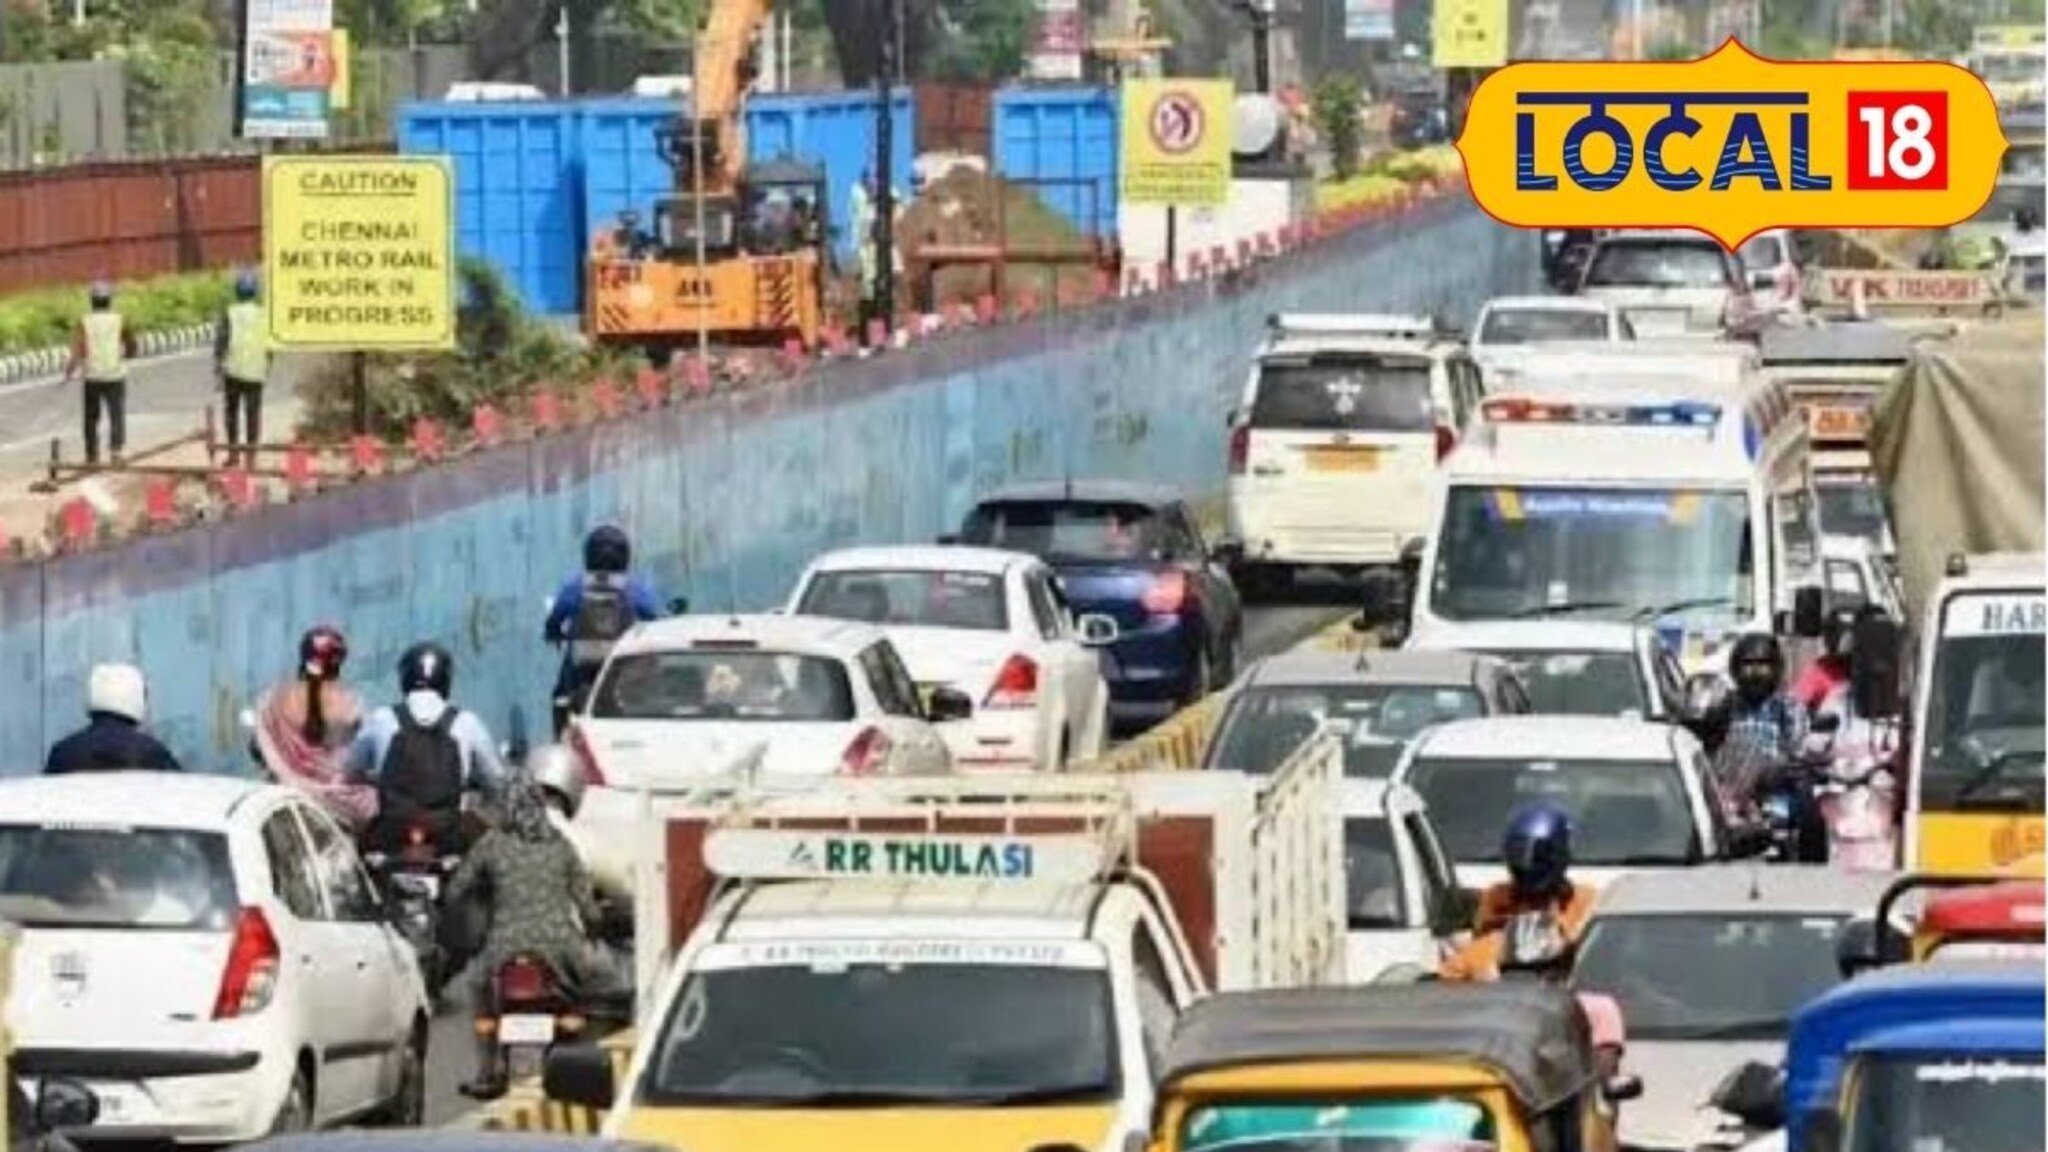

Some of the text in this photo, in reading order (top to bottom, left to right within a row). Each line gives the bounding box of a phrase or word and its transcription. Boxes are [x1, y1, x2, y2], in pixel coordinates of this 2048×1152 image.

[299, 172, 418, 190] CAUTION
[301, 221, 418, 241] CHENNAI
[279, 250, 440, 270] METRO RAIL
[299, 277, 414, 297] WORK IN
[288, 306, 434, 325] PROGRESS
[825, 839, 1033, 878] RR THULASI
